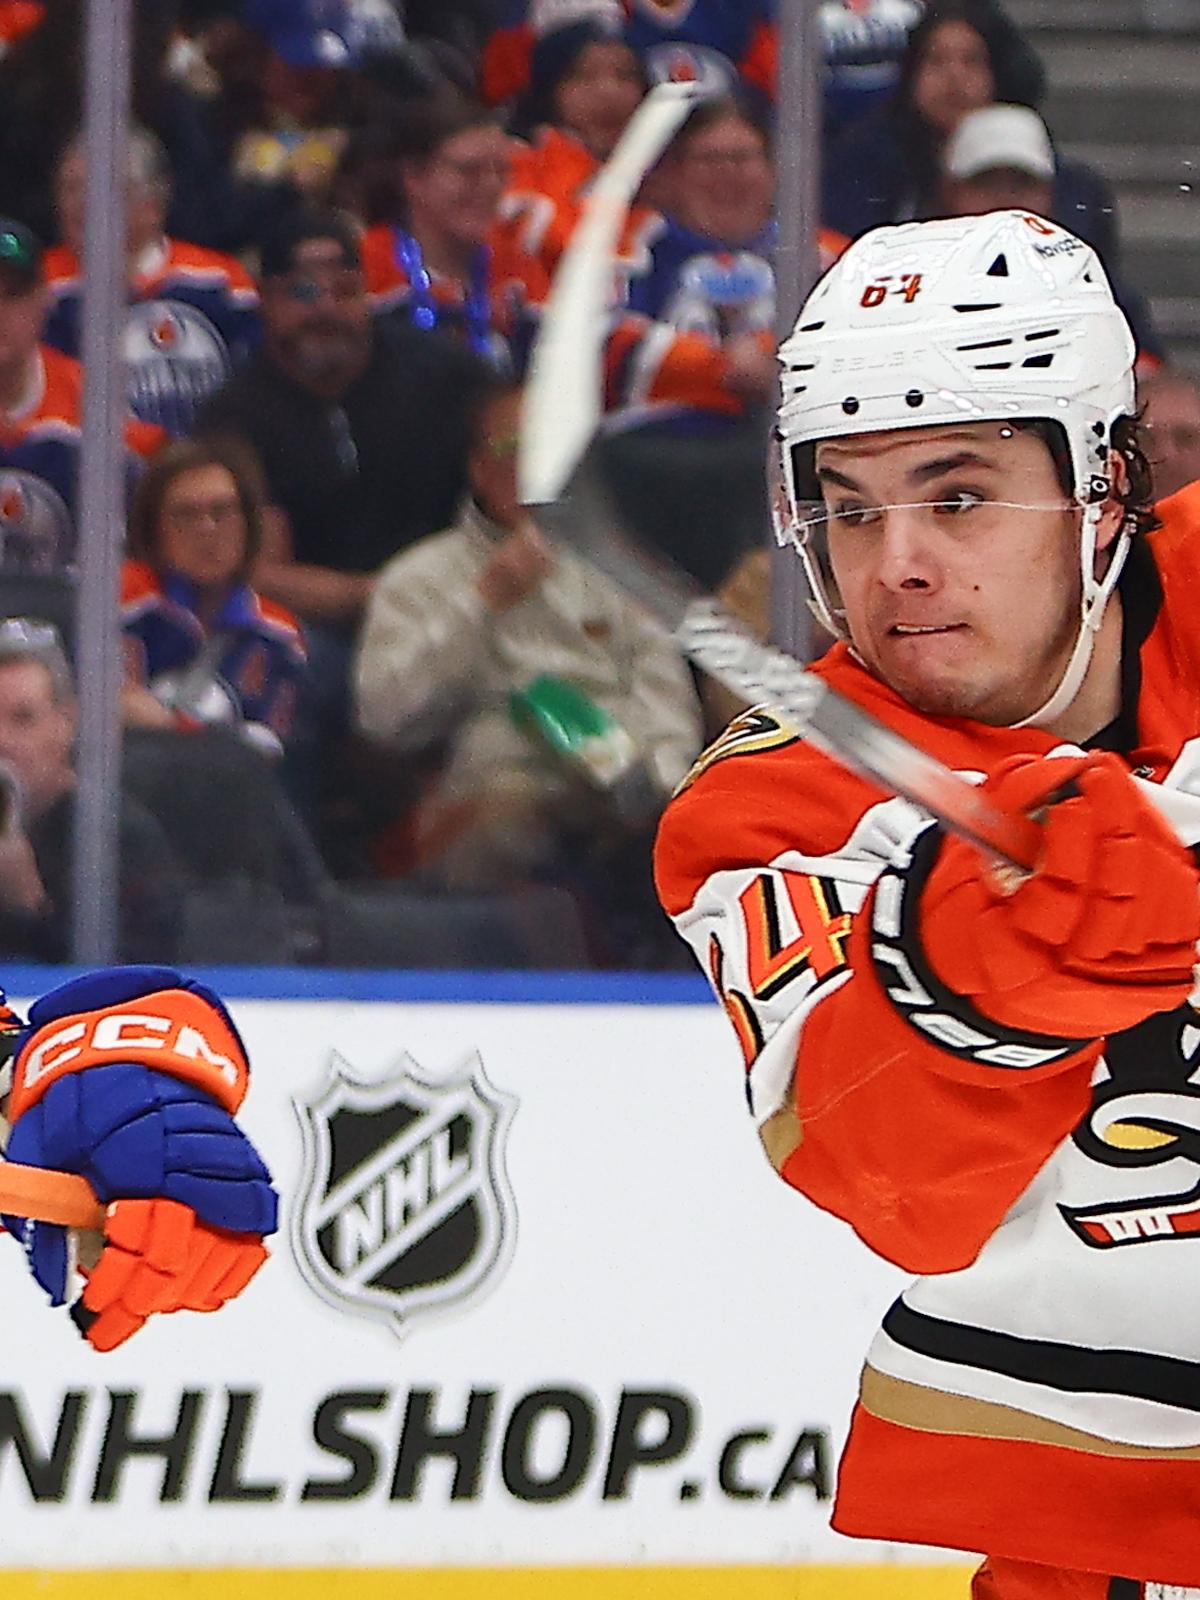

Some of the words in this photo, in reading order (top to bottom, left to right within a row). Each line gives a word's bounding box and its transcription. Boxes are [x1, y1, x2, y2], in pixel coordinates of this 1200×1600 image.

[859, 272, 924, 308] 64
[22, 1013, 240, 1089] CCM
[333, 1126, 471, 1270] NHL
[0, 1386, 833, 1505] NHLSHOP.CA
